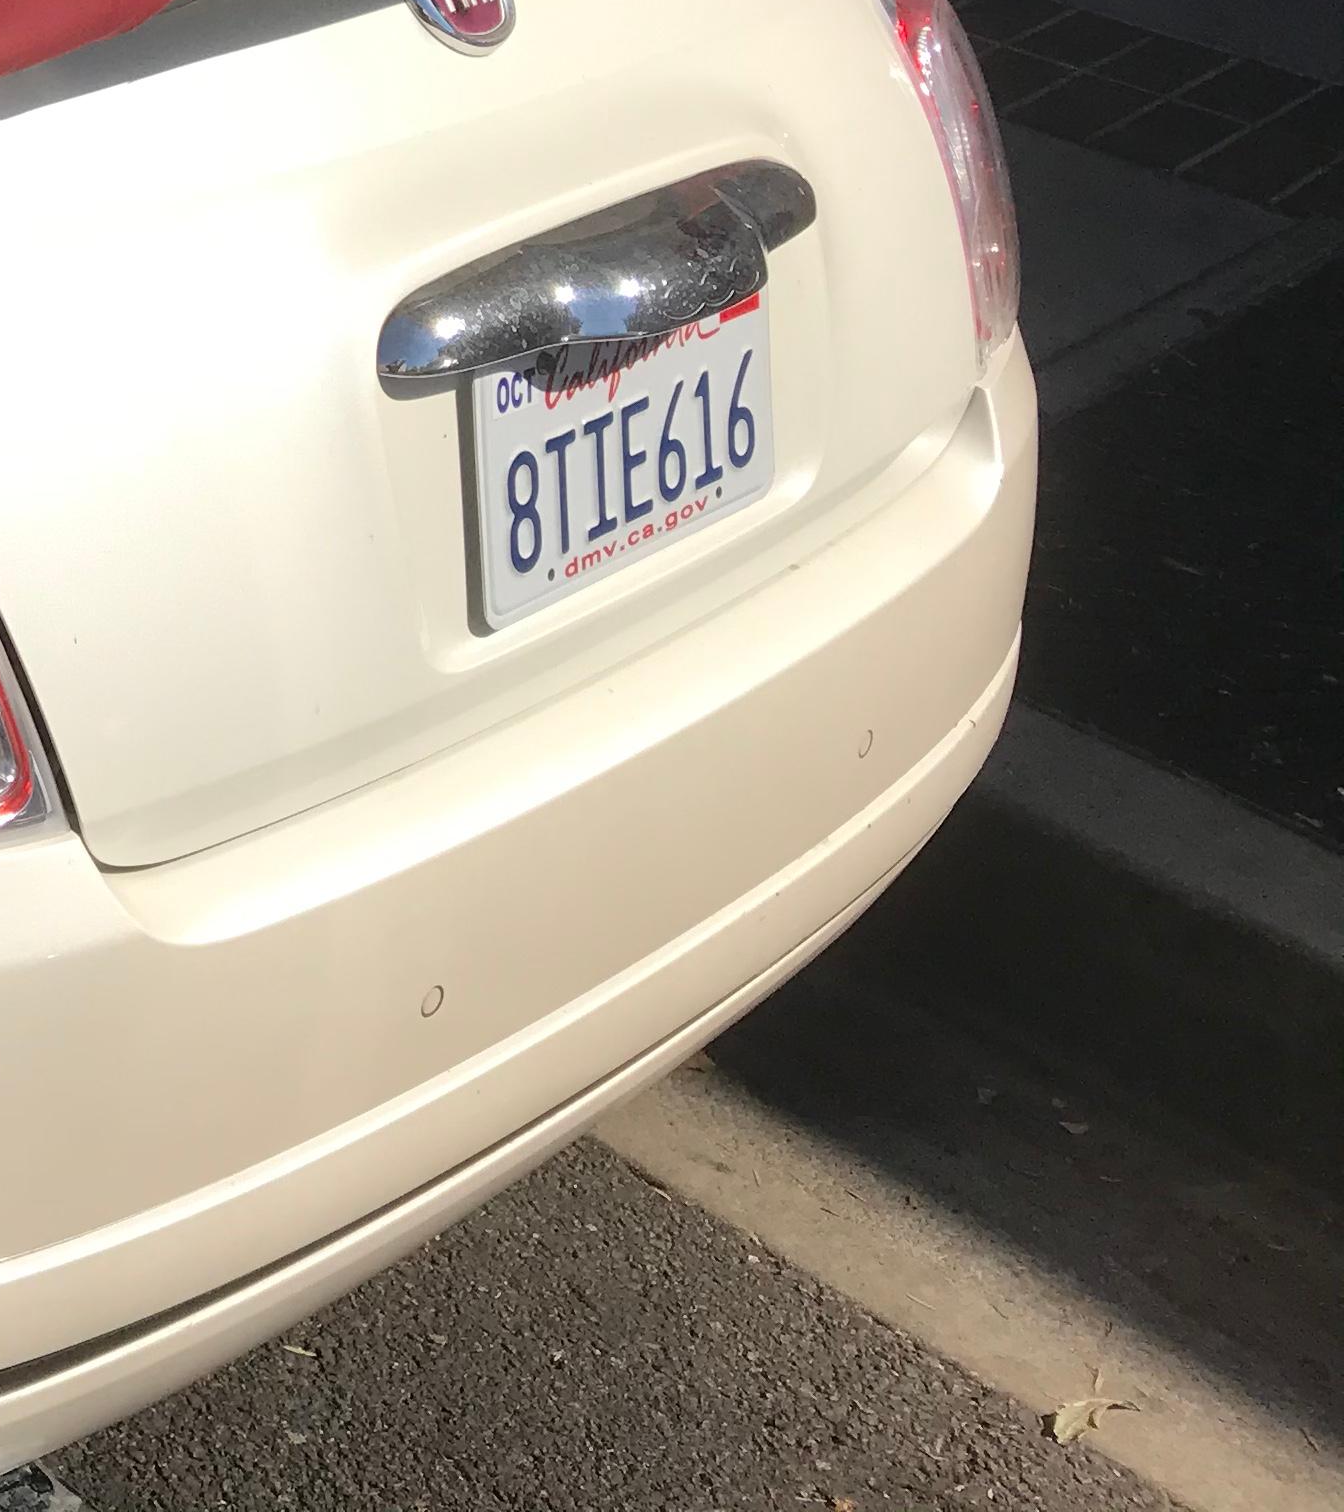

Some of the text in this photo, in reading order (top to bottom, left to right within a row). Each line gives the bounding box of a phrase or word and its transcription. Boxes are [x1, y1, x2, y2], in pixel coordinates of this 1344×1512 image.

[496, 367, 536, 414] OCT
[506, 348, 756, 574] 8TIE616
[564, 494, 709, 579] dmv.ca.gov
